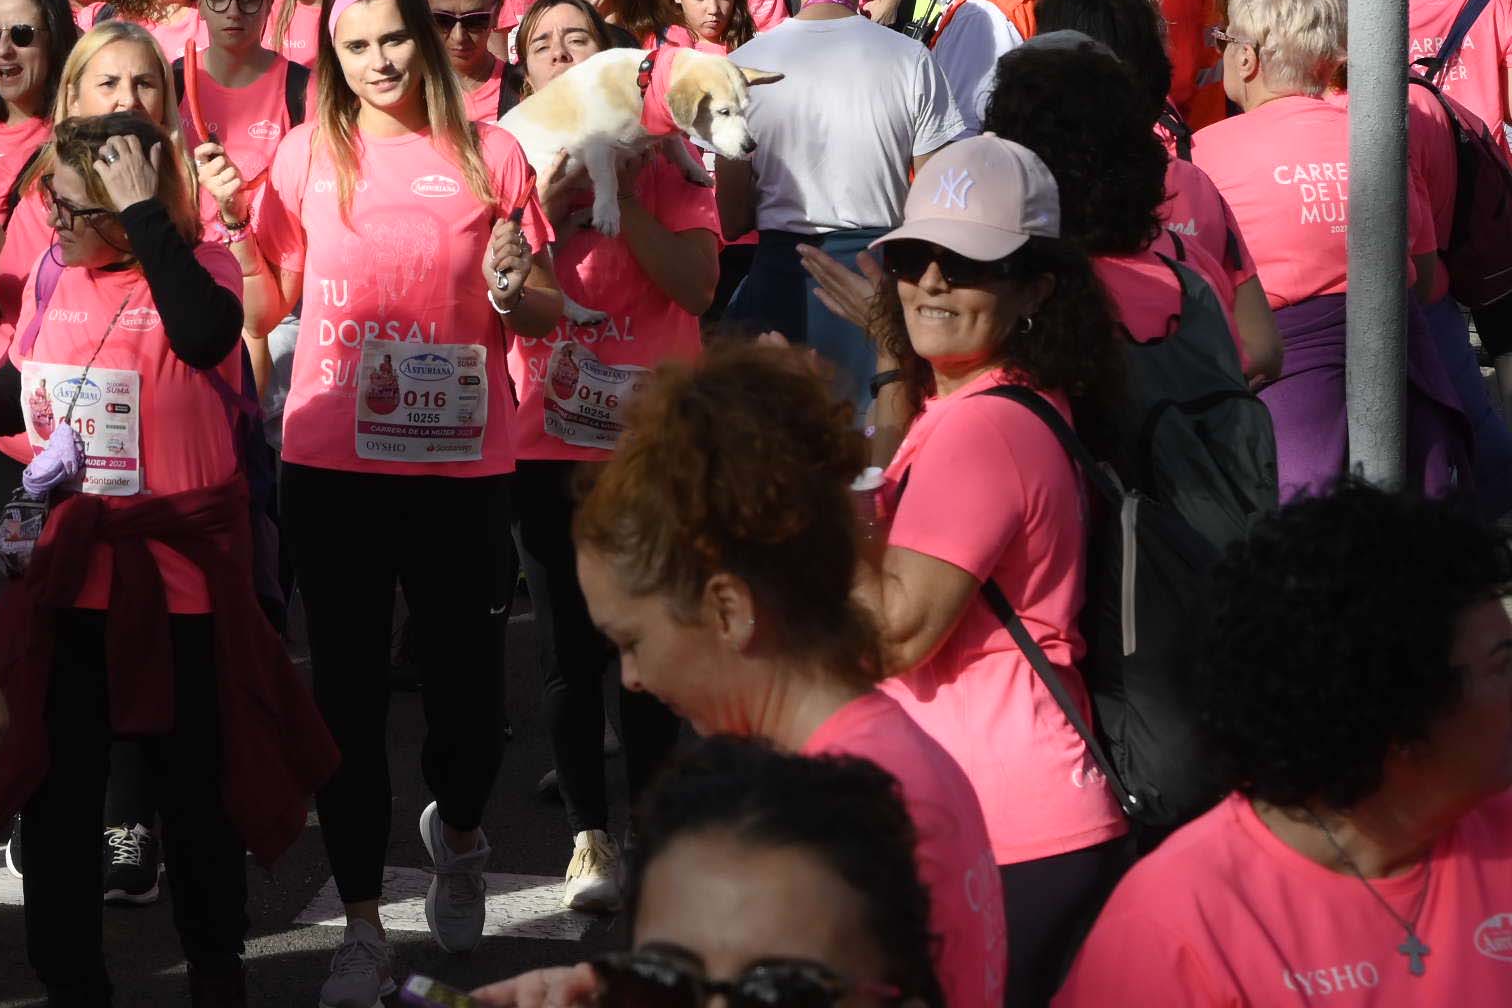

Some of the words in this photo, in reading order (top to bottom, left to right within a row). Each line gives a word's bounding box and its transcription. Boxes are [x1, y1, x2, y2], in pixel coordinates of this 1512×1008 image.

[1273, 162, 1348, 185] CARRE
[1300, 183, 1330, 203] DE
[319, 279, 348, 307] TU
[403, 390, 447, 408] 016
[578, 386, 618, 410] 016
[407, 412, 440, 423] 10255
[578, 404, 610, 419] 10254
[366, 441, 406, 453] OYSHO
[89, 473, 131, 487] Santander
[1282, 960, 1379, 996] OYSHO
